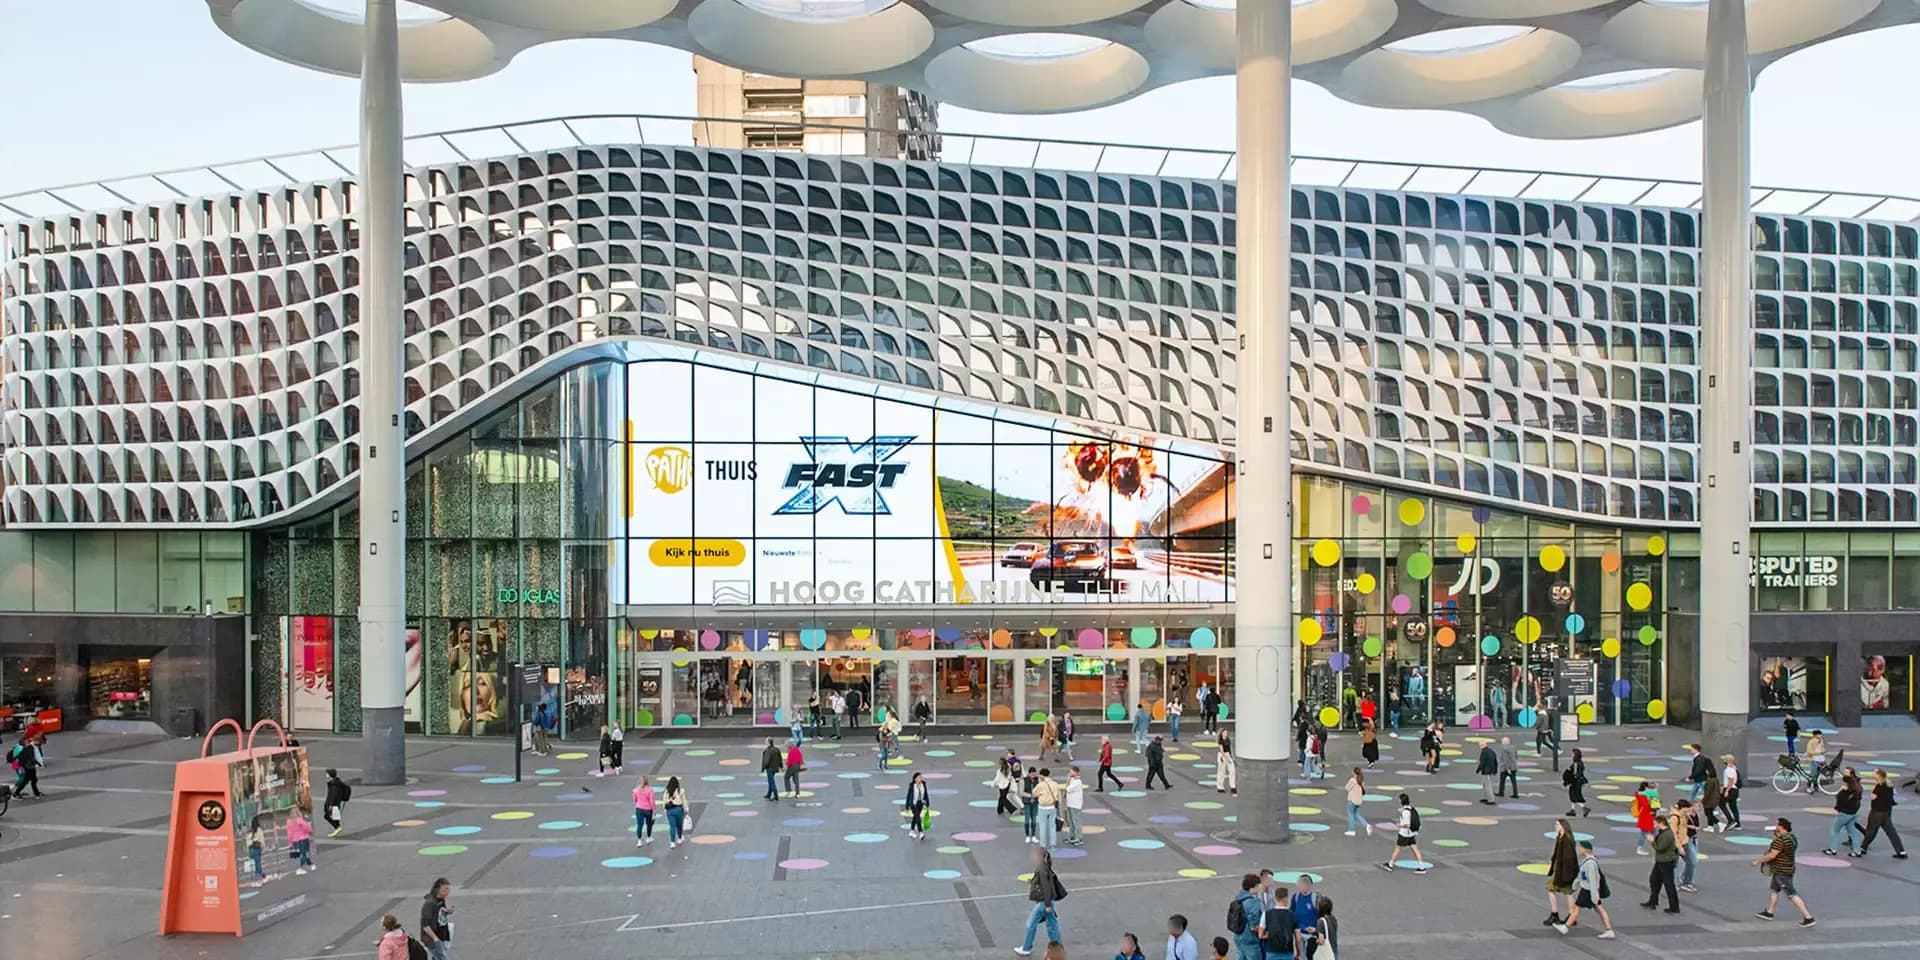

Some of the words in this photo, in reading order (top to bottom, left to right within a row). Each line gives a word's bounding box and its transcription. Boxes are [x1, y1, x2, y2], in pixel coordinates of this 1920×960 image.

[646, 450, 692, 489] PATH
[705, 460, 758, 481] THUIS
[782, 463, 908, 489] FAST
[665, 547, 685, 558] Kijk
[704, 547, 730, 557] thuis
[1448, 557, 1501, 596] JD
[770, 580, 865, 603] HOOG
[875, 580, 1066, 603] CATHARIJNE
[1077, 580, 1130, 603] THE
[1142, 580, 1208, 603] MALL
[1551, 585, 1571, 600] 50
[1406, 622, 1426, 636] 50
[201, 806, 223, 822] 50
